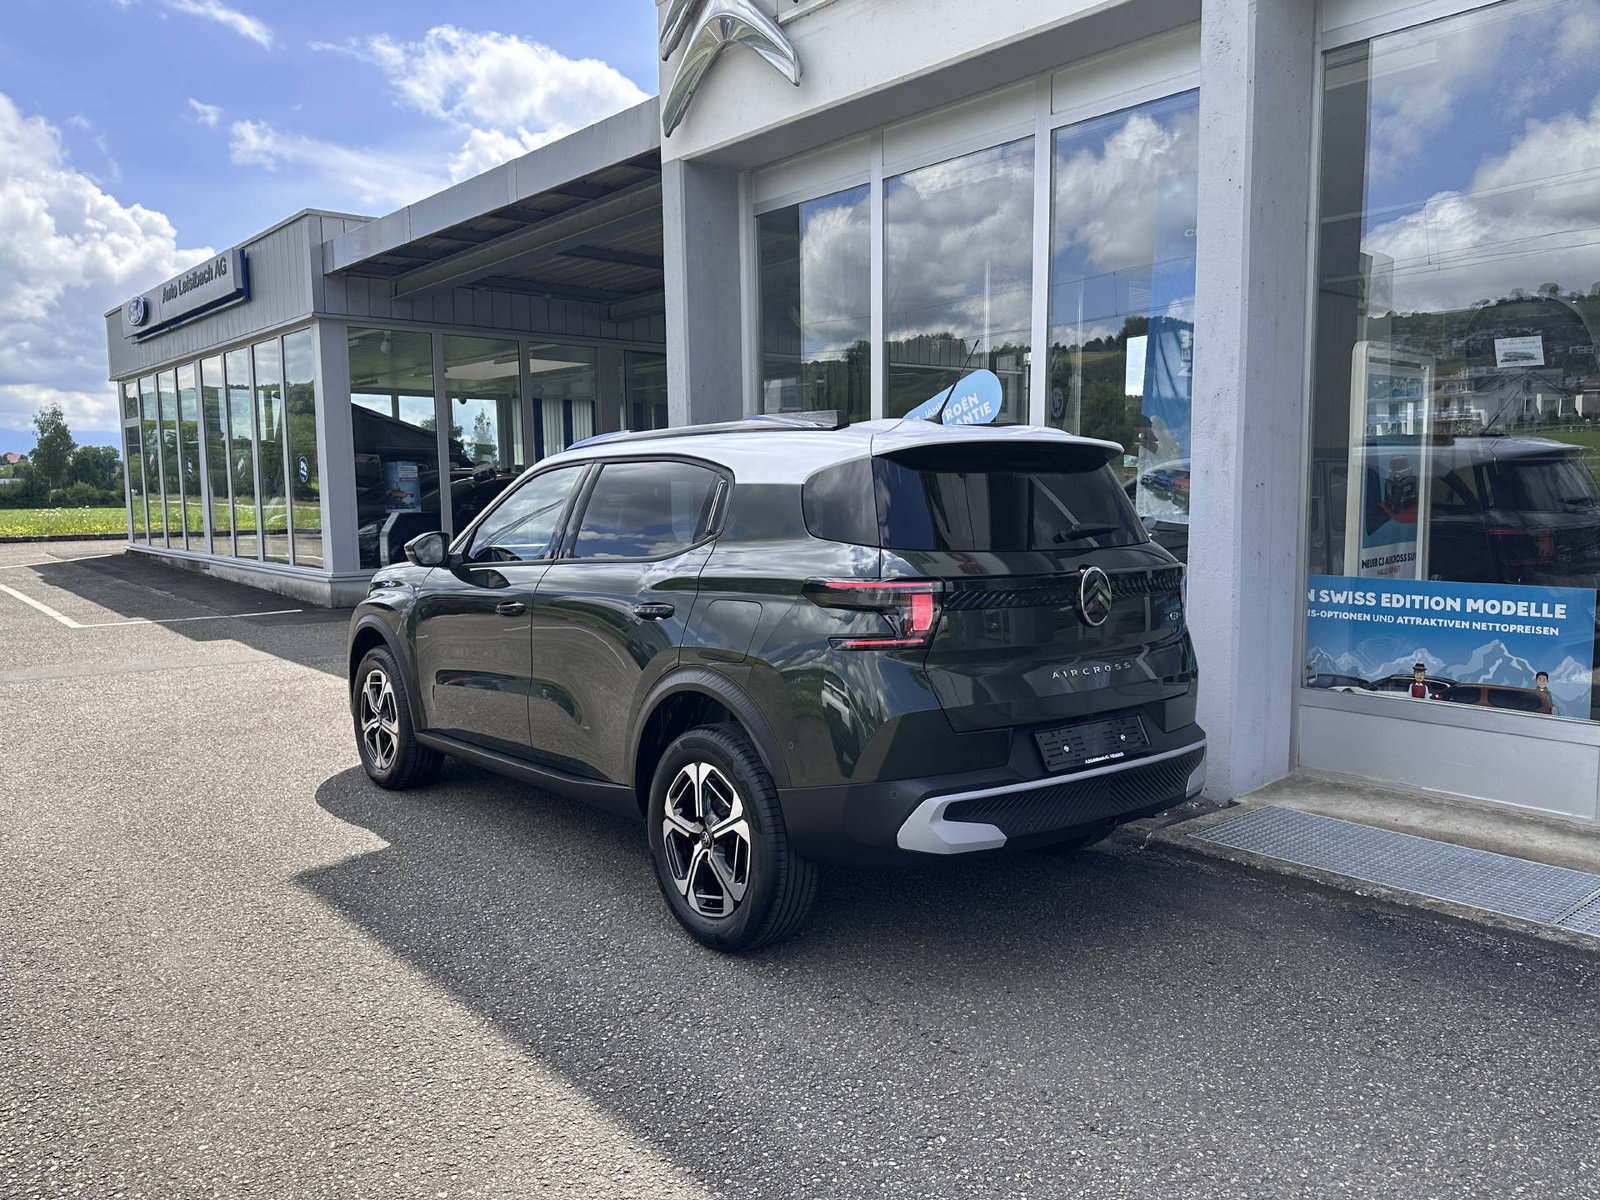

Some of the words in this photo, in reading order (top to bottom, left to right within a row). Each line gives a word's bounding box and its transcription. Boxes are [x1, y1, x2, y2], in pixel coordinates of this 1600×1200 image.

[162, 284, 178, 304] Auto
[214, 257, 227, 279] AG
[1361, 557, 1379, 569] NEUER
[1378, 556, 1385, 566] C3
[1319, 589, 1377, 606] SWISS
[1380, 593, 1461, 612] EDITION
[1466, 598, 1567, 619] MODELLE
[1372, 614, 1395, 623] UND
[1396, 616, 1470, 629] ATTRAKTIVEN
[1471, 621, 1559, 636] NETTOPREISEN
[1052, 661, 1131, 679] AIRCROSS
